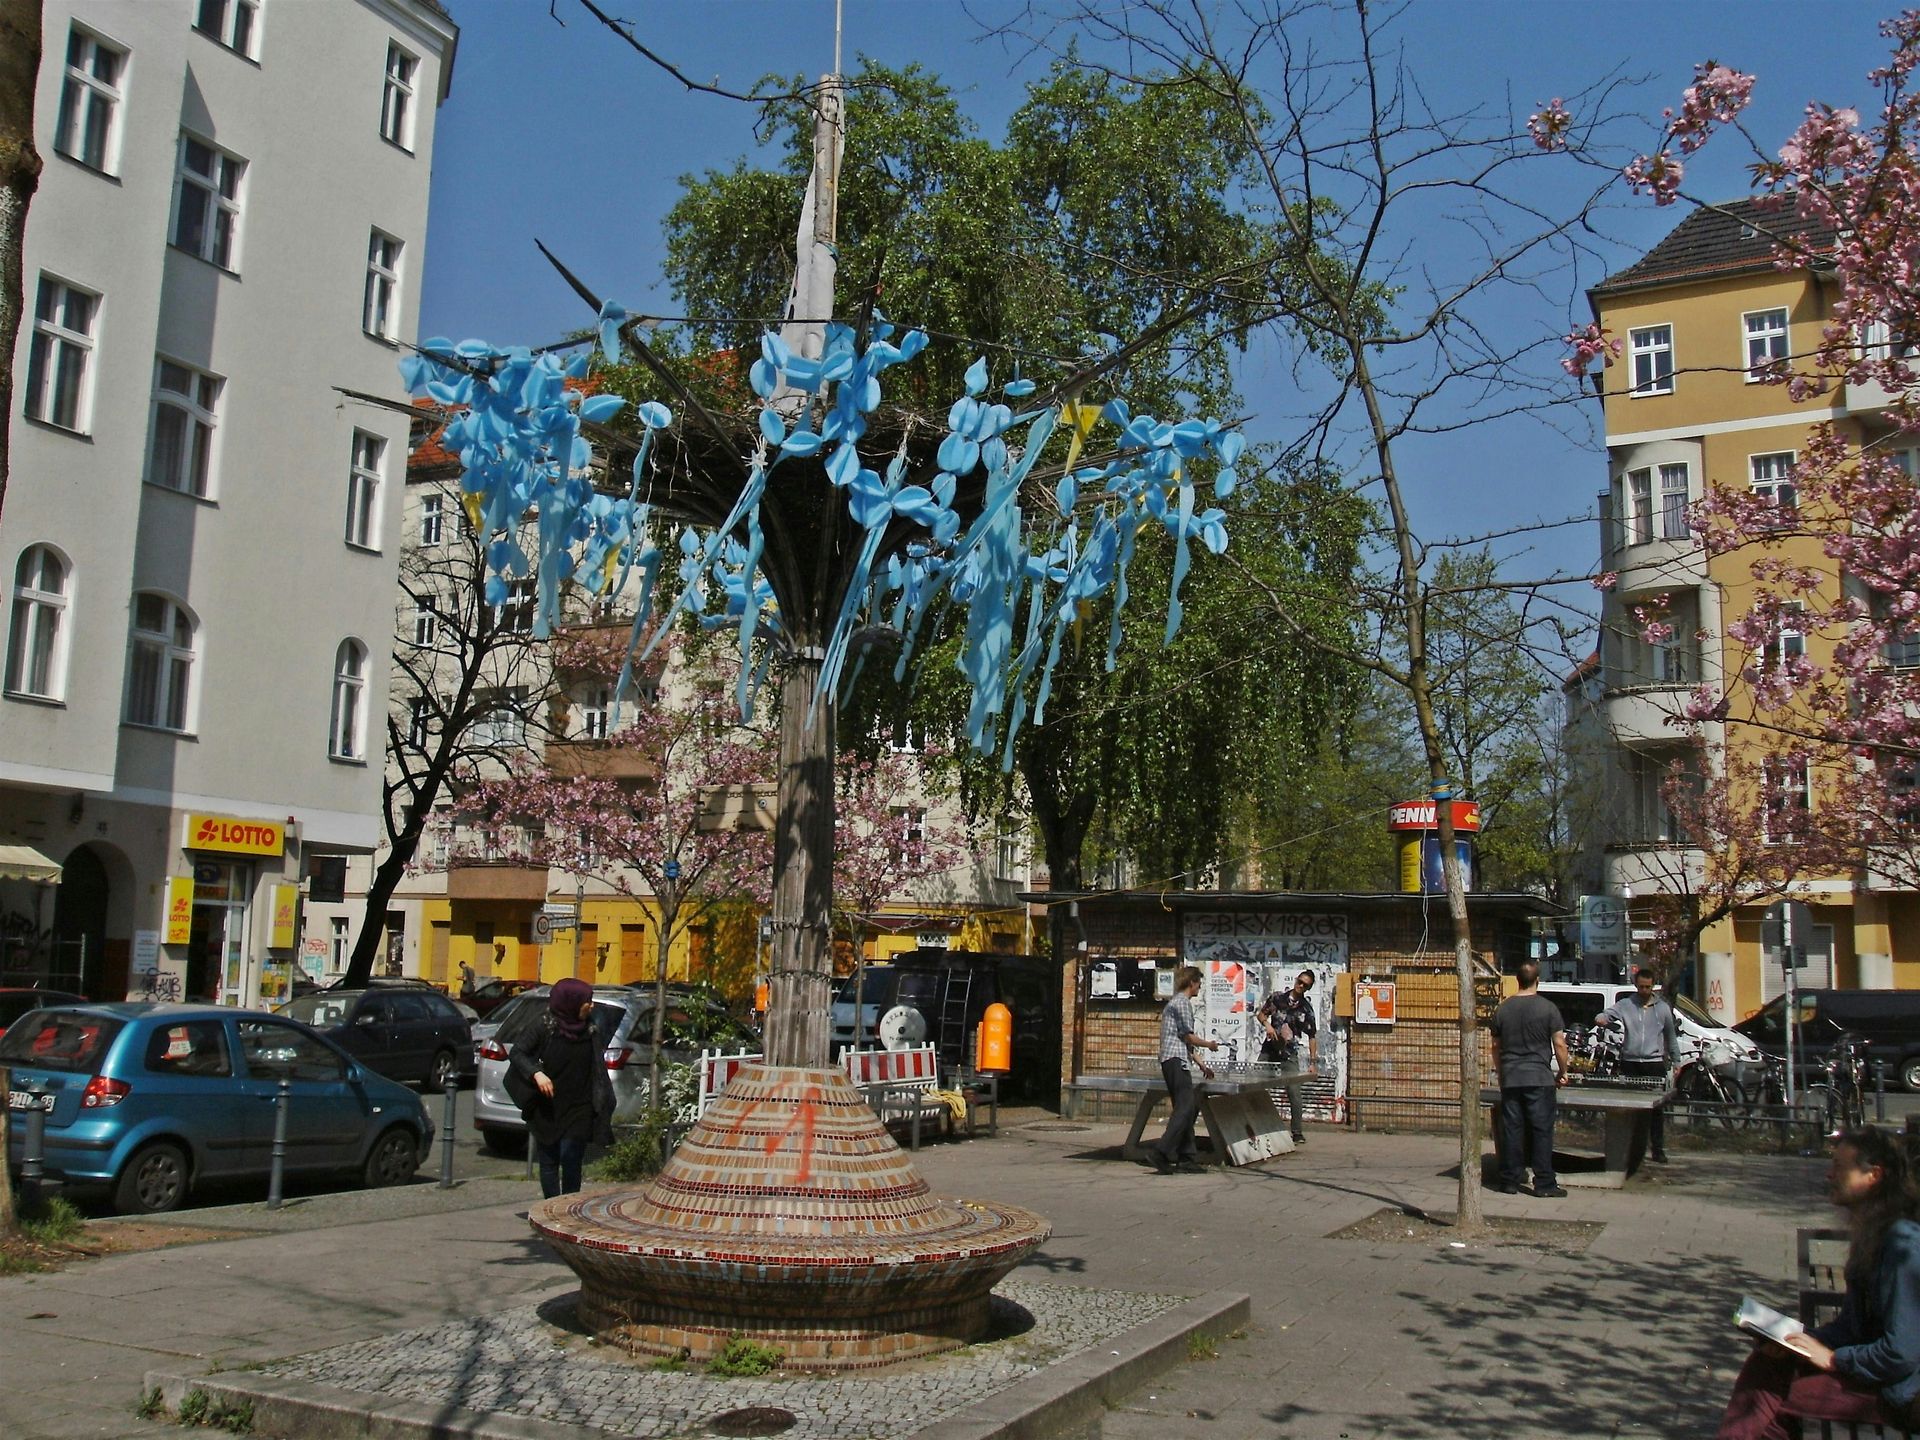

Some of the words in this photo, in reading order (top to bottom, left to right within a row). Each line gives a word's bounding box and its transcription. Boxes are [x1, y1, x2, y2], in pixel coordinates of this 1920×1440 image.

[1391, 807, 1437, 824] PENN
[221, 823, 275, 846] LOTTO
[169, 914, 190, 922] LOTTO
[1710, 979, 1723, 994] M
